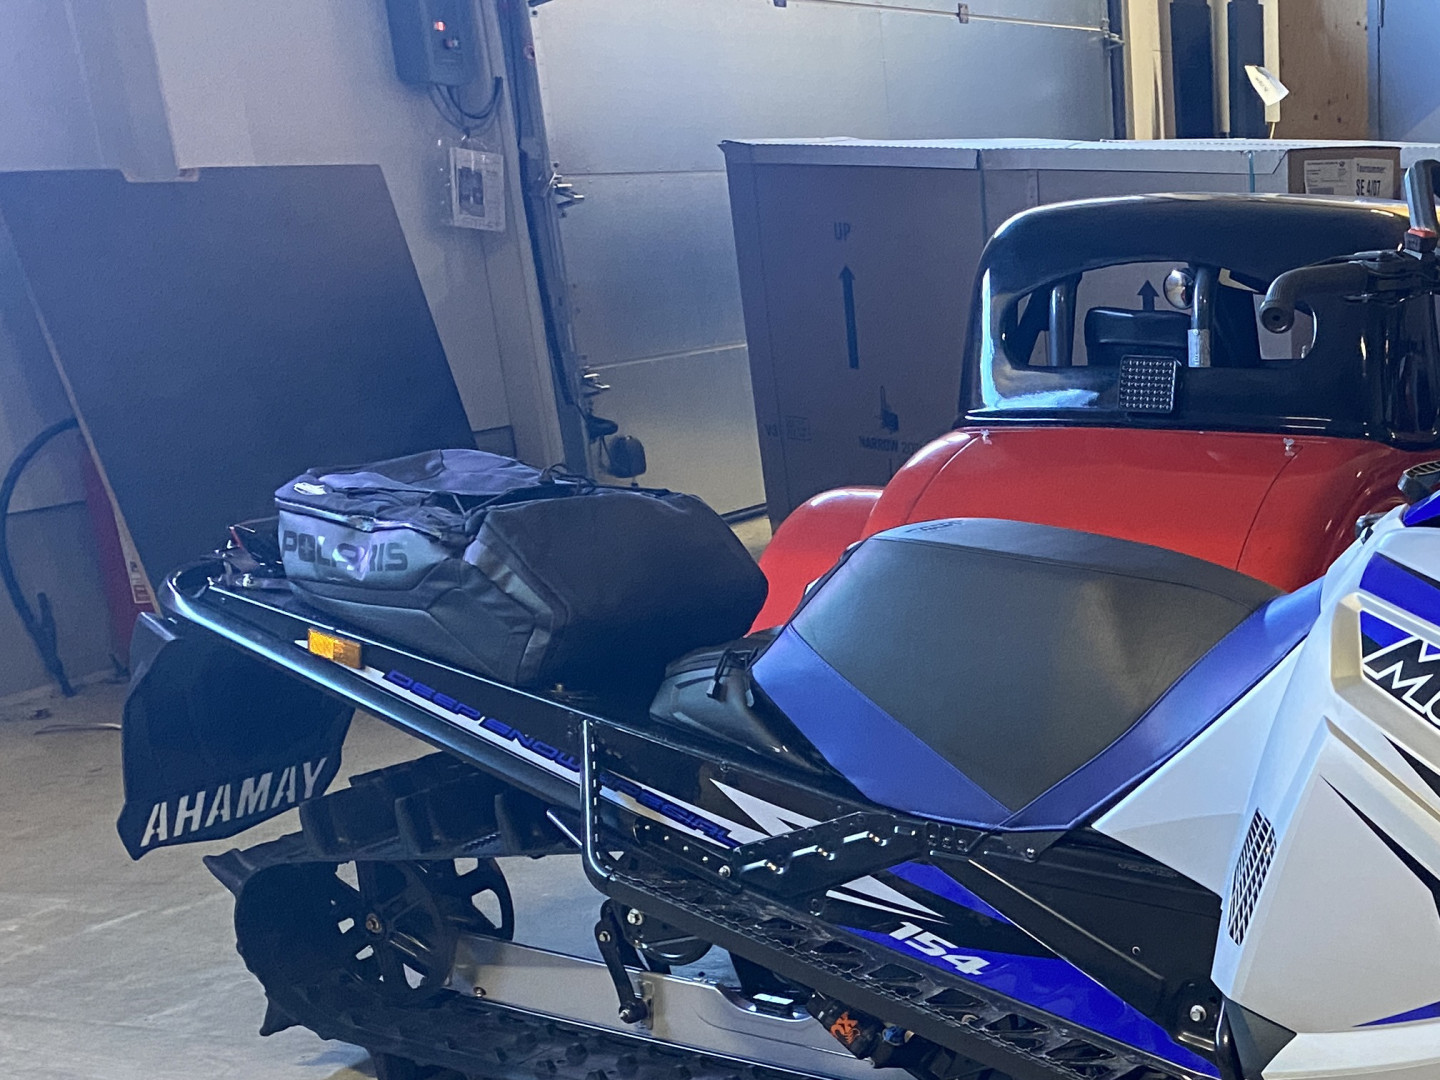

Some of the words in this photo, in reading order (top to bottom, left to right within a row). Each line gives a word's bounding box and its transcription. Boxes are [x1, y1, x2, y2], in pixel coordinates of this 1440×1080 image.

[833, 221, 851, 241] UP
[383, 669, 481, 723] DEEP
[888, 921, 991, 976] 154
